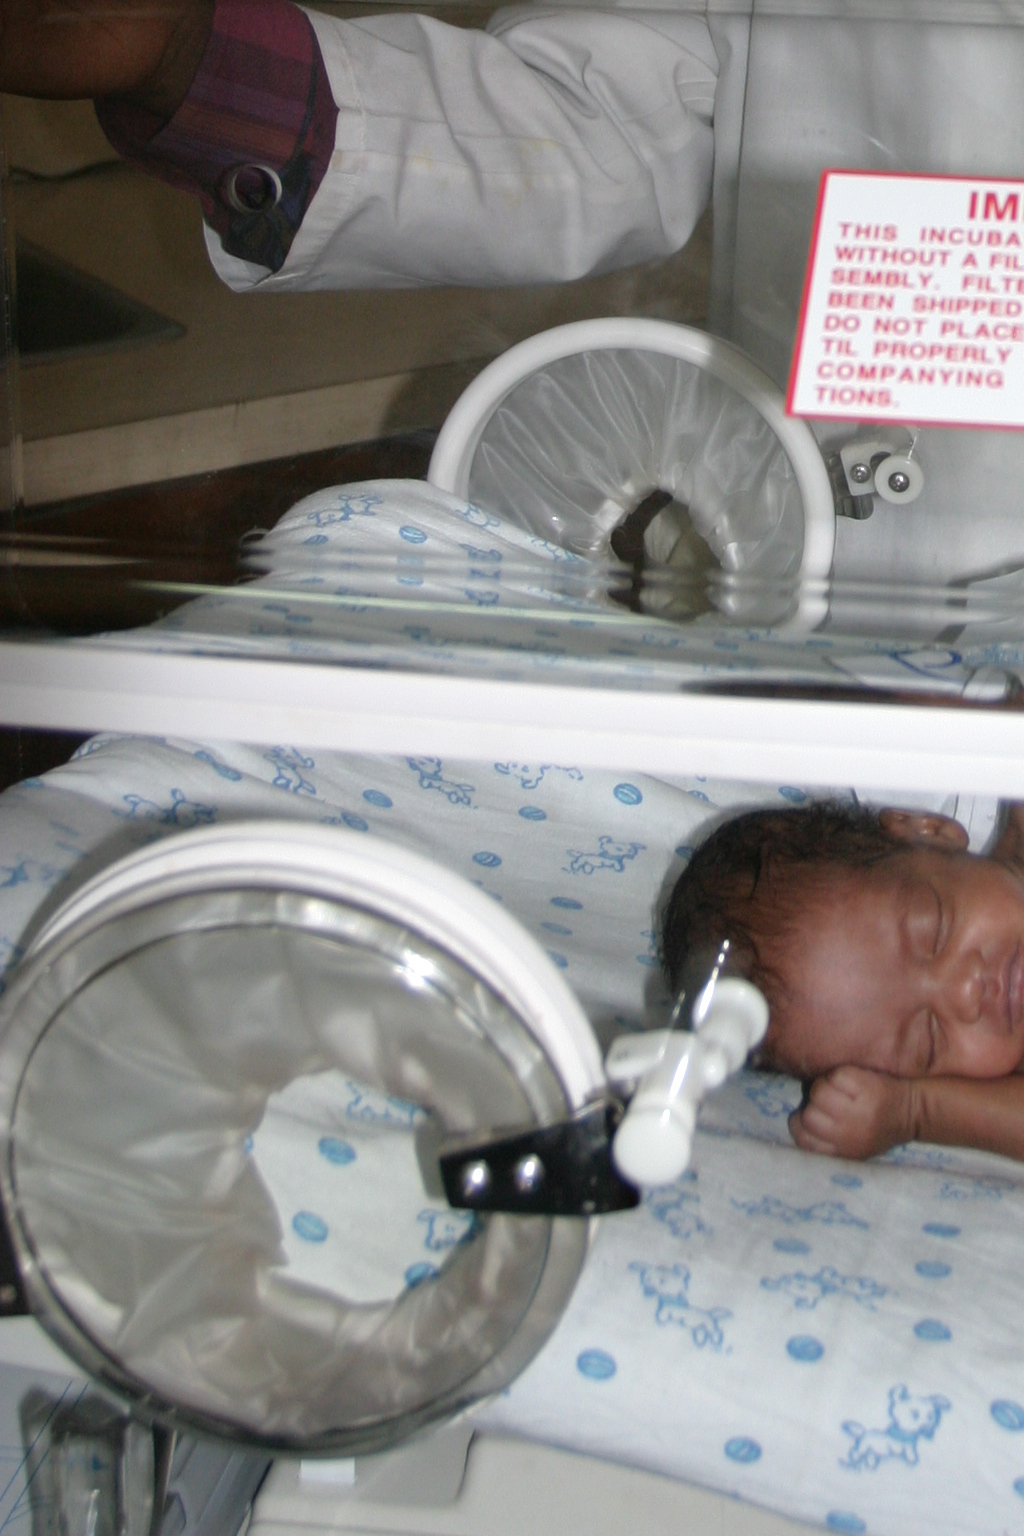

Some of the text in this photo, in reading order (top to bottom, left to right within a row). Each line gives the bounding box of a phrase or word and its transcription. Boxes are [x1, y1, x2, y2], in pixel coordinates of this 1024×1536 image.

[839, 223, 897, 242] THIS
[835, 247, 949, 266] WITHOUT
[962, 253, 978, 268] A
[831, 269, 941, 289] SEMBLY.
[827, 292, 895, 311] BEEN
[913, 297, 1023, 317] SHIPPED
[823, 315, 861, 332] DO
[873, 318, 925, 335] NOT
[940, 322, 1024, 342] PLACE
[822, 337, 858, 357] TIL
[873, 341, 1010, 364] PROPERLY
[816, 363, 1004, 389] COMPANYING
[816, 386, 899, 408] TIONS.
